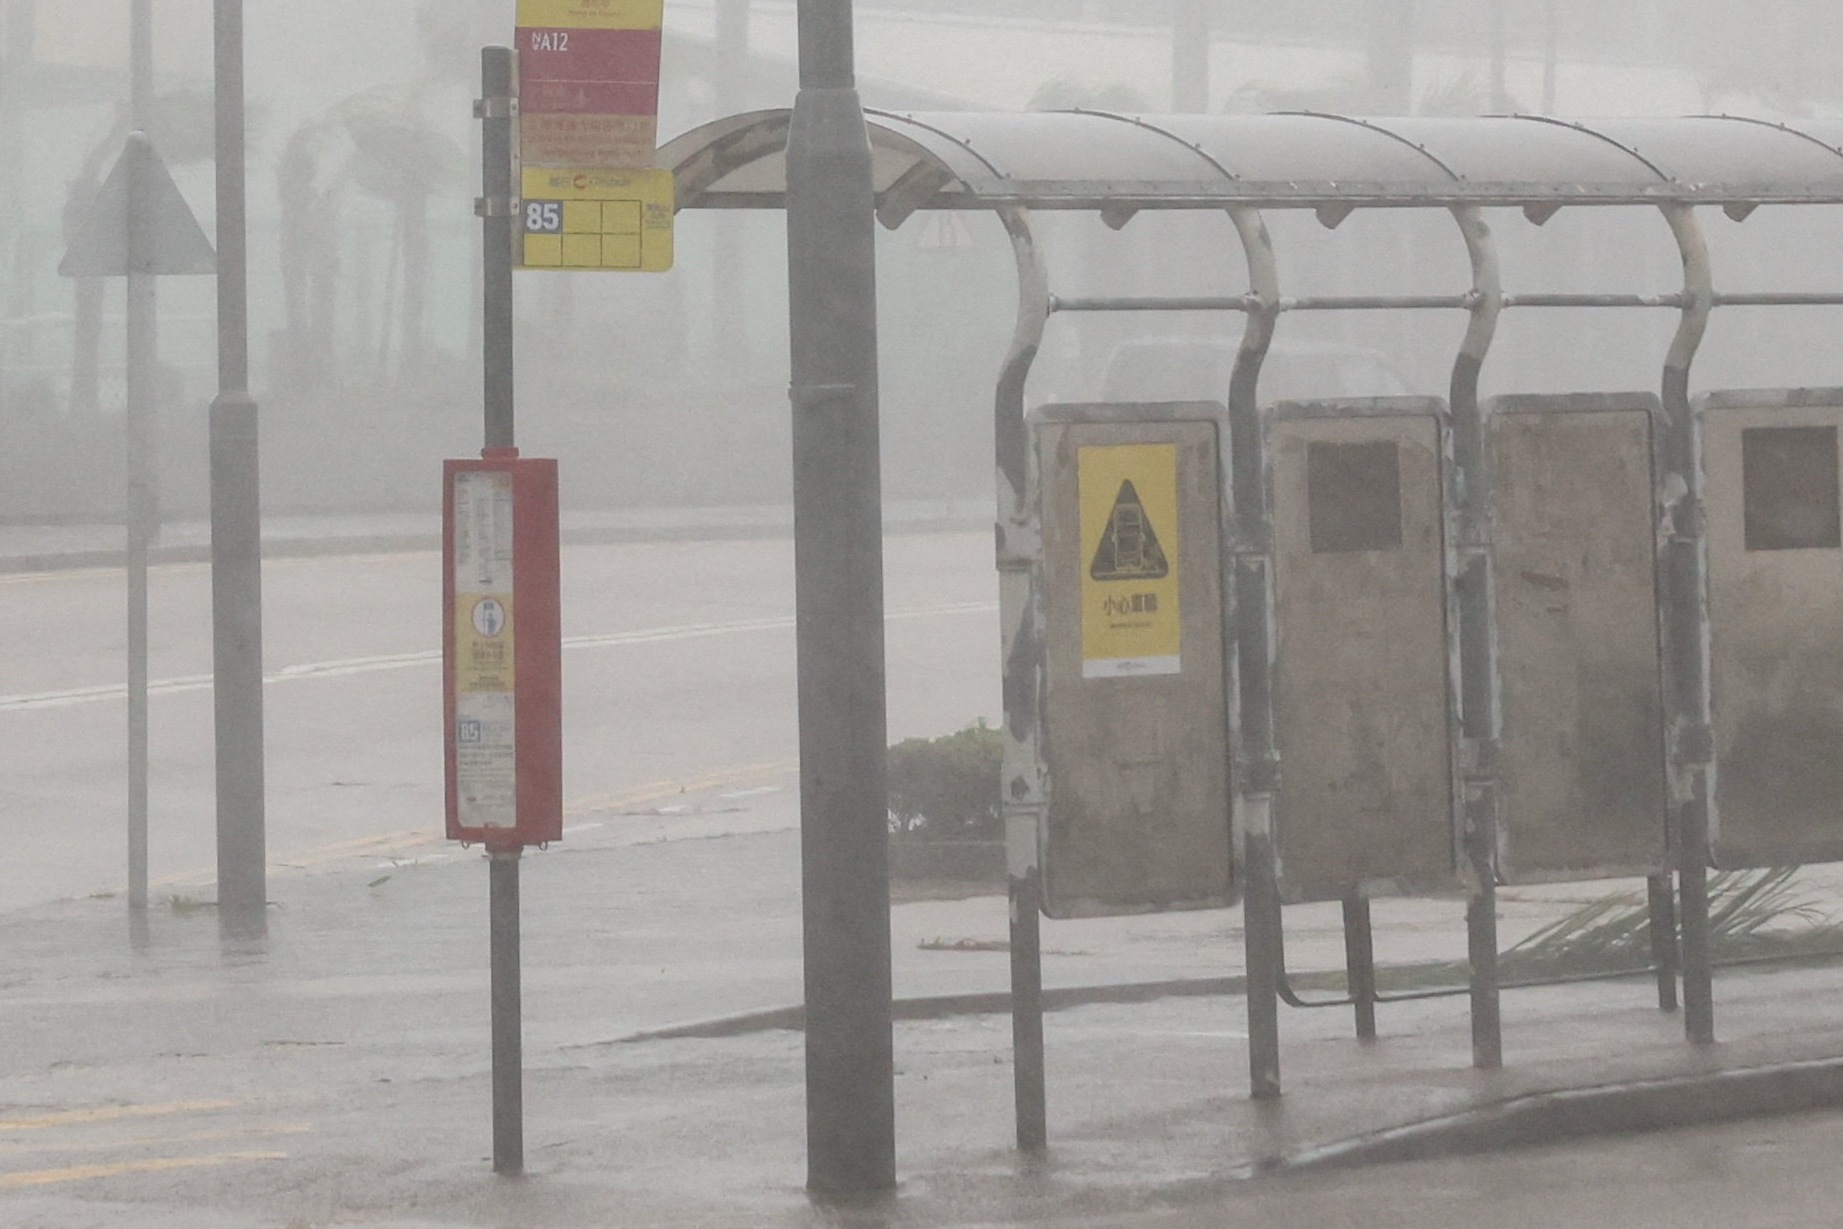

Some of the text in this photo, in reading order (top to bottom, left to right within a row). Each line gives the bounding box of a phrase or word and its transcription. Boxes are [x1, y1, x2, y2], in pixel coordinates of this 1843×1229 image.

[526, 202, 559, 230] 85
[1103, 593, 1157, 616] 小心
[461, 723, 478, 740] 85
